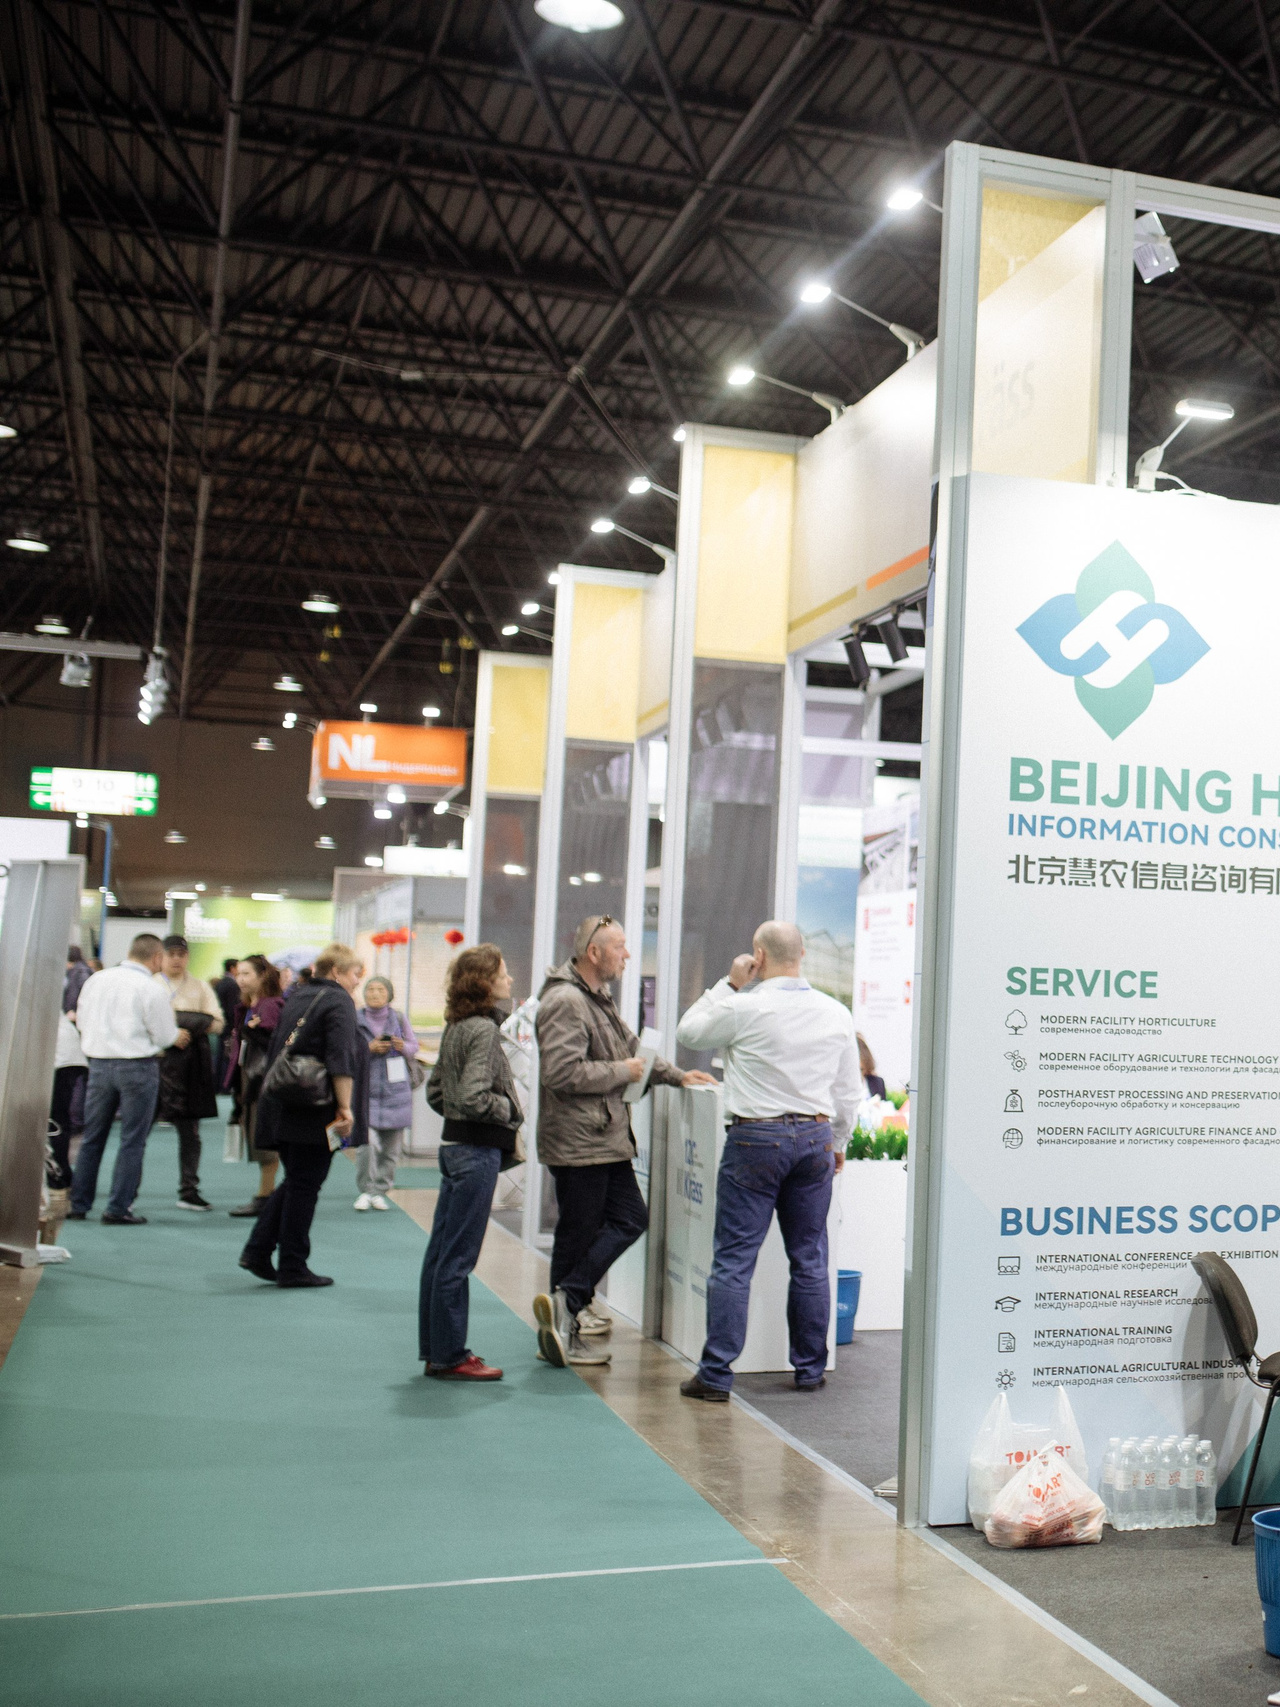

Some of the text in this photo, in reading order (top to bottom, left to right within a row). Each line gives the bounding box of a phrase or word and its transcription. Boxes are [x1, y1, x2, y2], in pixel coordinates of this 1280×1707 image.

[328, 733, 391, 773] NL
[1009, 757, 1232, 813] BEIJING
[1007, 813, 1209, 846] INFORMATION
[1005, 966, 1158, 999] SERVICE
[1040, 1015, 1217, 1028] MODERN FACILITY HORTICULTURE
[1039, 1026, 1162, 1036] современное садоводство
[1039, 1052, 1086, 1062] MODERN
[1089, 1053, 1135, 1063] FACILITY
[1137, 1054, 1208, 1064] AGRICULTURE
[1210, 1055, 1279, 1065] TECHNOLOGY
[1039, 1063, 1101, 1072] современное
[1103, 1063, 1169, 1073] оборудование
[1233, 1066, 1250, 1074] для
[1038, 1089, 1116, 1099] POSTHARVEST
[1118, 1090, 1183, 1100] PROCESSING
[1185, 1091, 1208, 1100] AND
[1038, 1100, 1118, 1110] послеуборочную
[1120, 1100, 1168, 1110] обработку
[1179, 1102, 1240, 1110] консервацию
[1037, 1127, 1084, 1136] MODERN
[1087, 1127, 1133, 1136] FACILITY
[1135, 1127, 1206, 1136] AGRICULTURE
[1208, 1127, 1252, 1136] FINANCE
[1254, 1127, 1277, 1136] AND
[1036, 1137, 1117, 1147] финансирование
[1128, 1138, 1174, 1147] логистику
[1177, 1138, 1240, 1147] современного
[1000, 1205, 1178, 1236] BUSINESS
[1036, 1253, 1122, 1264] INTERNATIONAL
[1125, 1252, 1193, 1262] CONFERENCE
[1221, 1250, 1279, 1260] EXHIBITION
[1035, 1262, 1187, 1274] международные конференции
[1035, 1289, 1178, 1301] INTERNATIONAL RESEARCH
[1034, 1301, 1118, 1311] международные
[1120, 1299, 1162, 1308] научные
[1034, 1326, 1173, 1339] INTERNATIONAL TRAINING
[1033, 1336, 1172, 1349] международная подготовка
[1033, 1366, 1119, 1376] INTERNATIONAL
[1121, 1361, 1199, 1373] AGRICULTURAL
[1032, 1371, 1224, 1388] международная сельскохозяйственная
